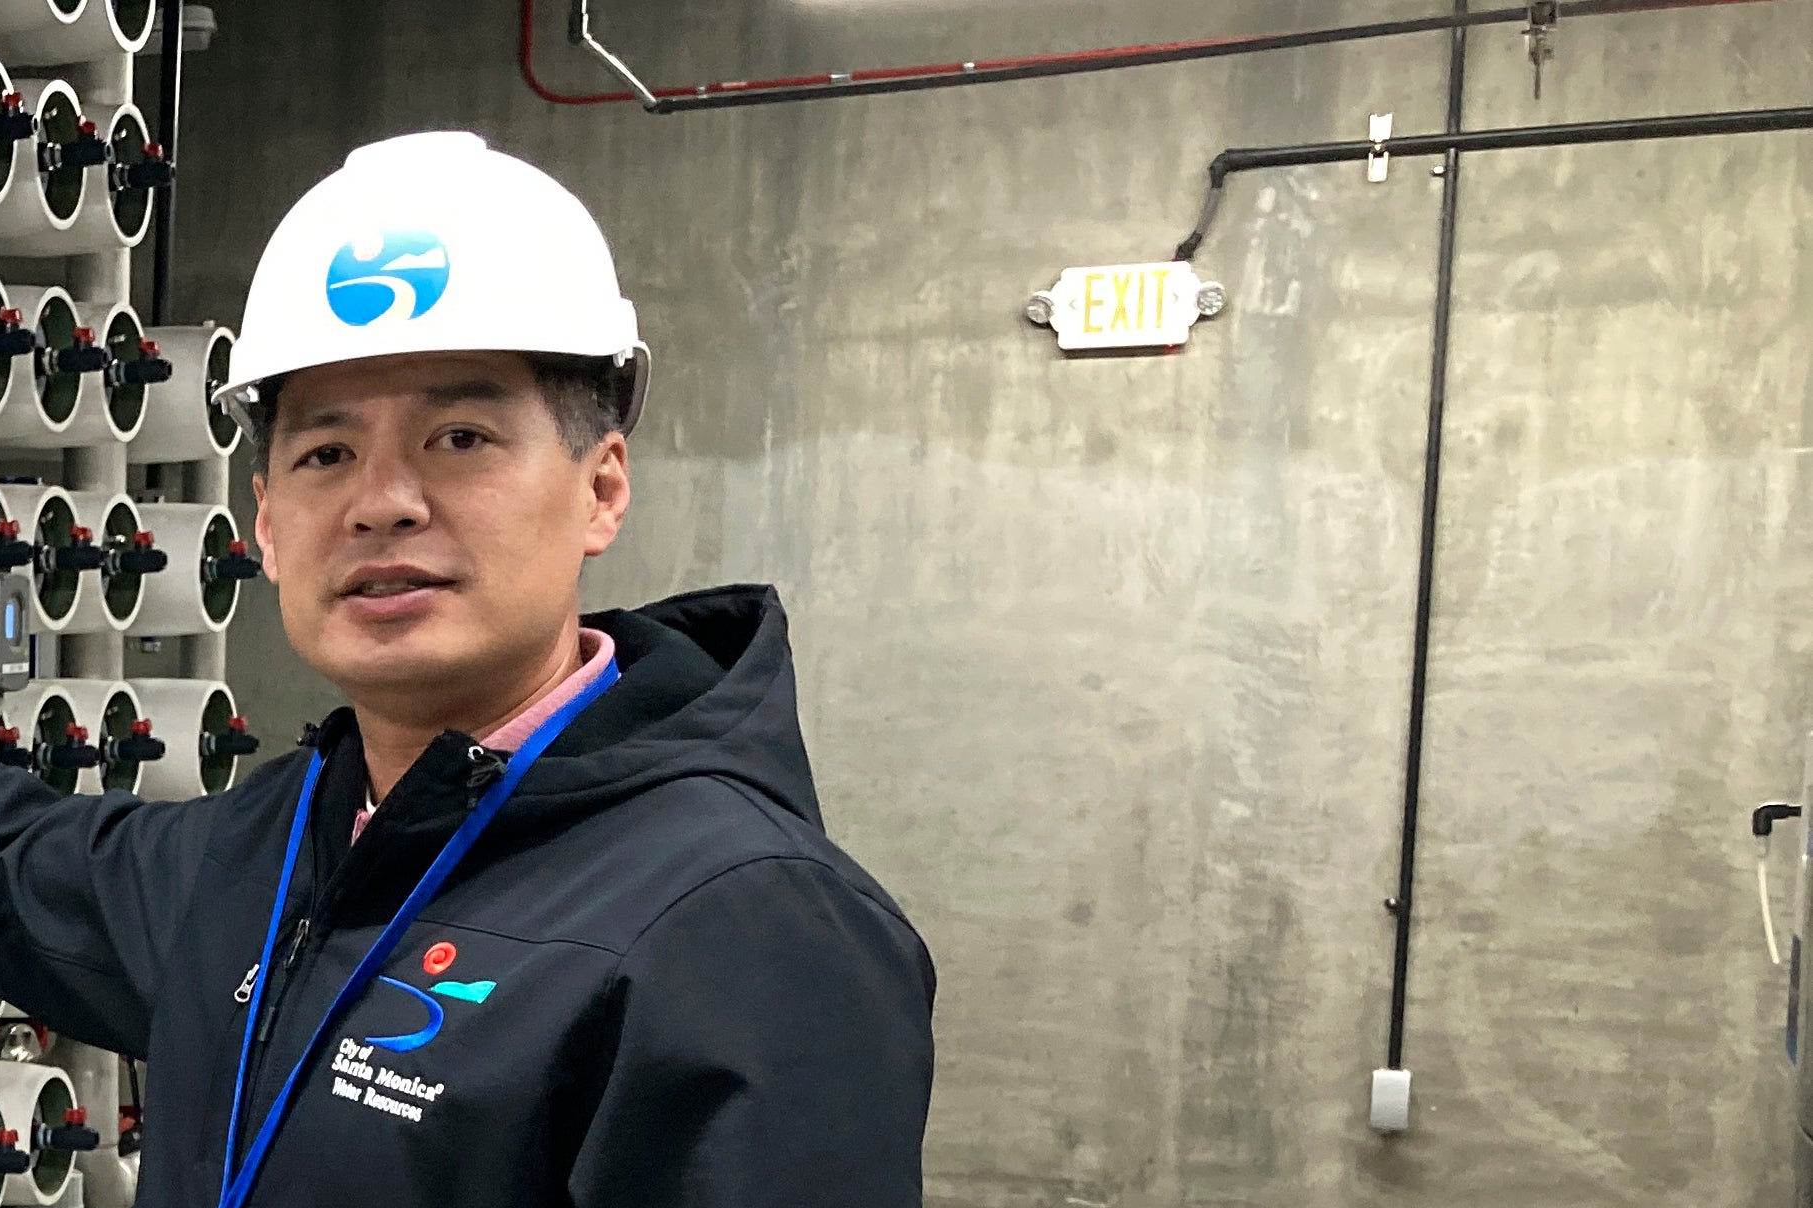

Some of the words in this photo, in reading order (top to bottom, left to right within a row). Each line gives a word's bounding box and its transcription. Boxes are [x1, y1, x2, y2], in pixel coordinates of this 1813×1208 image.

[1084, 269, 1171, 333] EXIT
[331, 1053, 373, 1081] Santa
[340, 1038, 361, 1060] City
[358, 1045, 374, 1061] of
[332, 1076, 362, 1102] Water
[363, 1086, 423, 1122] Resources
